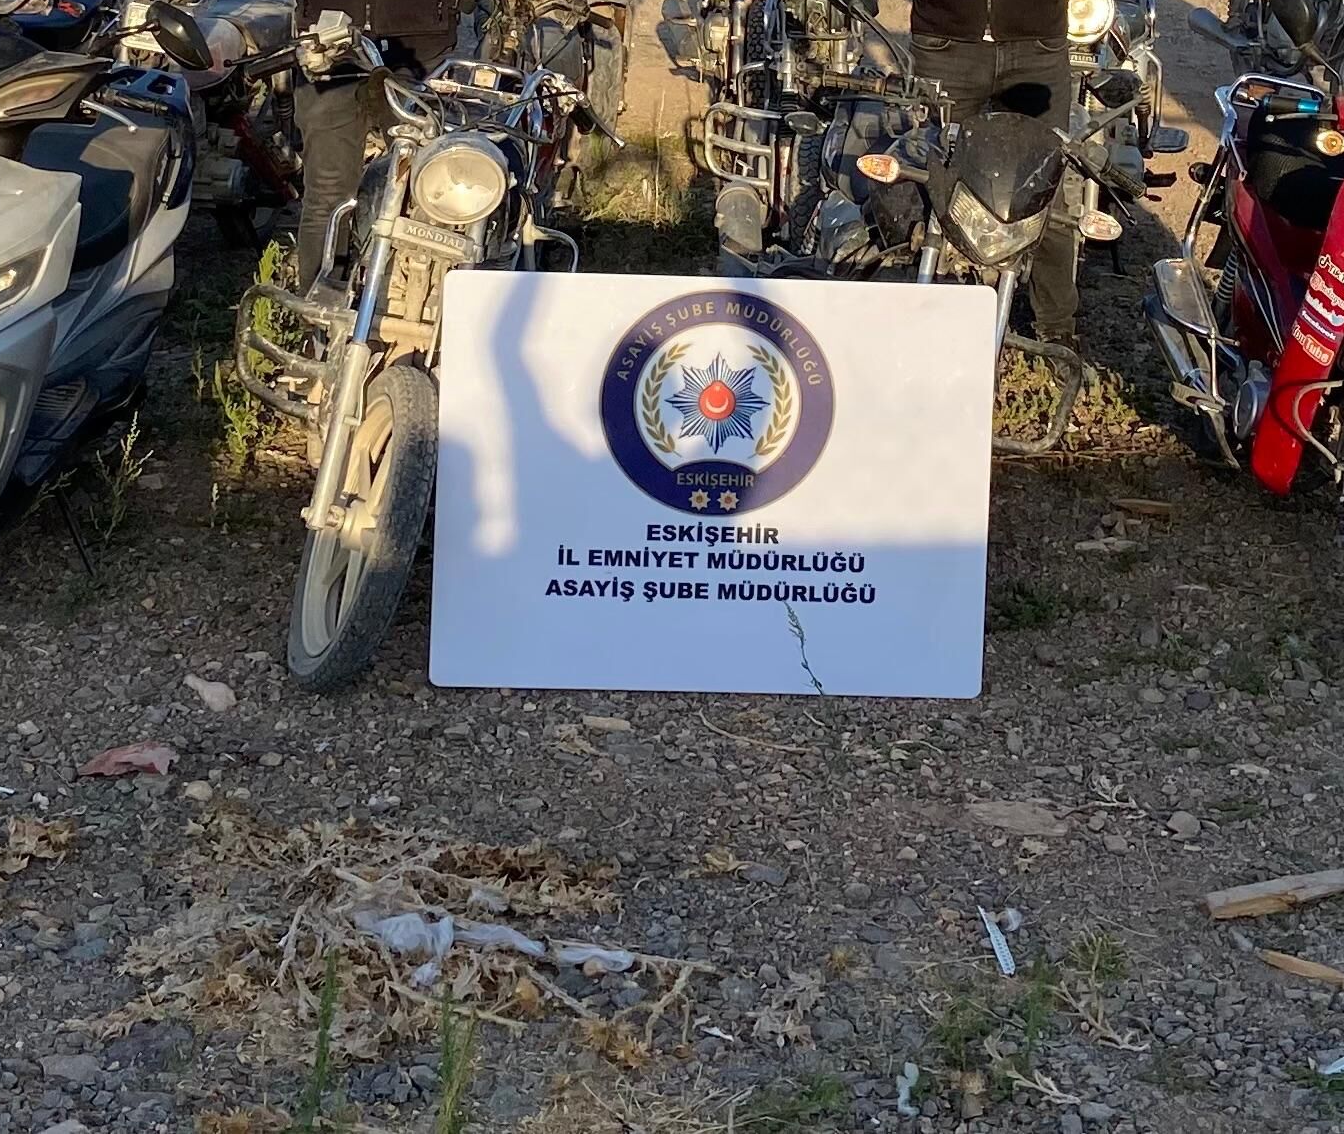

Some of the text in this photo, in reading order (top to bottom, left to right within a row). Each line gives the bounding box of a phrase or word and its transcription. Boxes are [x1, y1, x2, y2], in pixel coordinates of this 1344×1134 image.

[1069, 54, 1096, 64] nuni
[406, 225, 462, 249] MONDIAL
[1302, 310, 1337, 341] facebook
[616, 301, 822, 387] ASAYİŞ ŞUBE MÜDÜRLÜĞÜ
[676, 470, 755, 489] ESKİŞEHİR
[646, 521, 779, 546] ESKİŞEHİR
[557, 544, 866, 573] İL EMNİYET MÜDÜRLÜĞÜ
[545, 576, 876, 604] ASAYİŞ ŞUBE MÜDÜRLÜĞÜ
